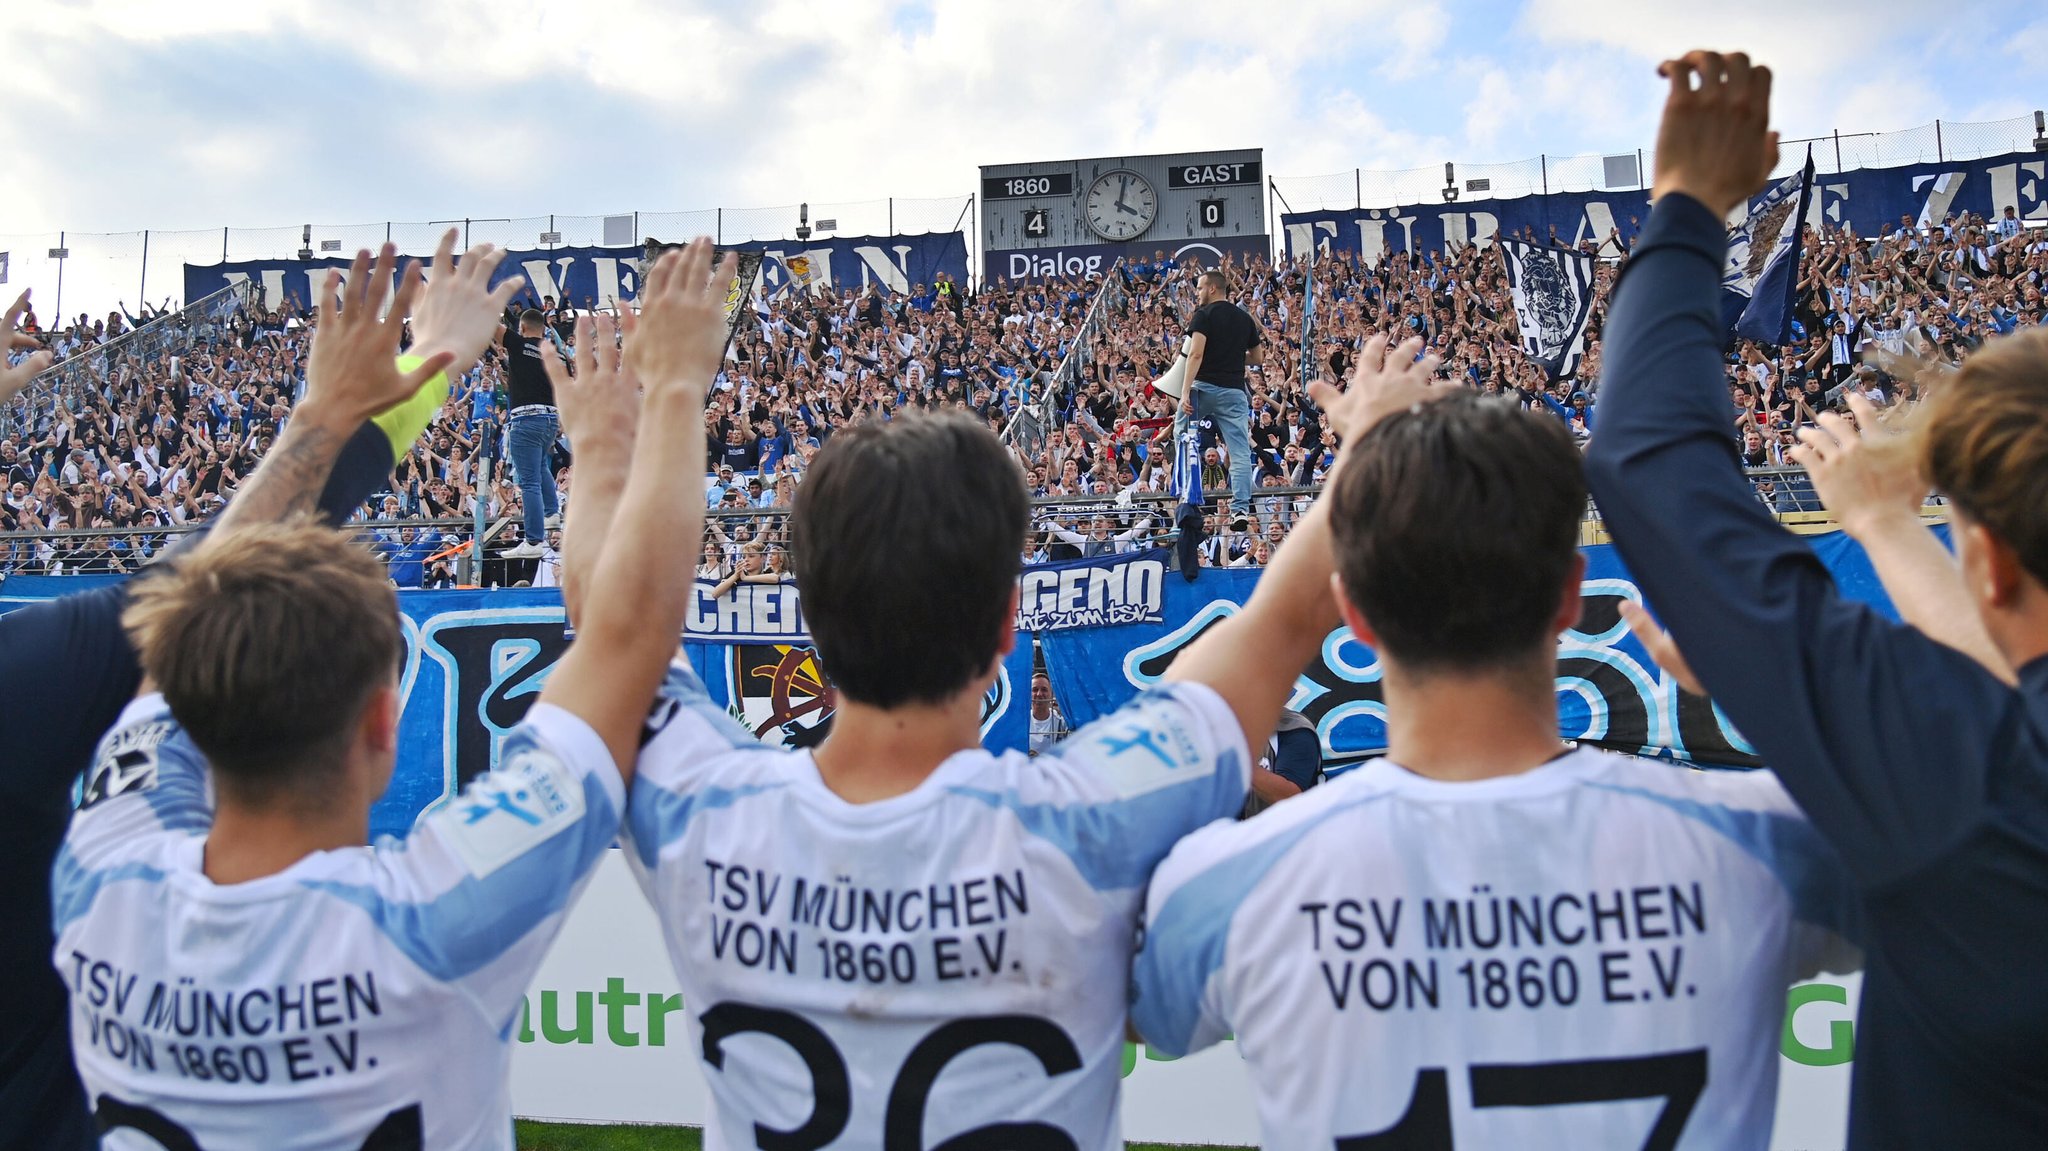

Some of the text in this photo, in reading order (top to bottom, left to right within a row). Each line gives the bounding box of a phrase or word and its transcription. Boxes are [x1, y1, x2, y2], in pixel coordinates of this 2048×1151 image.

[1004, 178, 1051, 196] 1860
[1183, 164, 1245, 184] GAST
[1027, 214, 1045, 235] 4
[1205, 204, 1218, 224] 0
[1570, 182, 1851, 258] AE
[520, 244, 914, 311] VEEIN
[1009, 251, 1102, 282] Dialog
[681, 582, 811, 633] CHEN
[1014, 560, 1164, 614] GEND
[705, 859, 1030, 934] TSV MÜNCHEN
[1301, 882, 1708, 951] TSV MÜNCHEN
[712, 913, 1022, 984] VON 1860 E.V.
[1321, 945, 1698, 1012] VON 1860 E.V.
[72, 950, 382, 1038] TSV MÜNCHEN
[82, 1003, 379, 1085] VON 1860 E.V.
